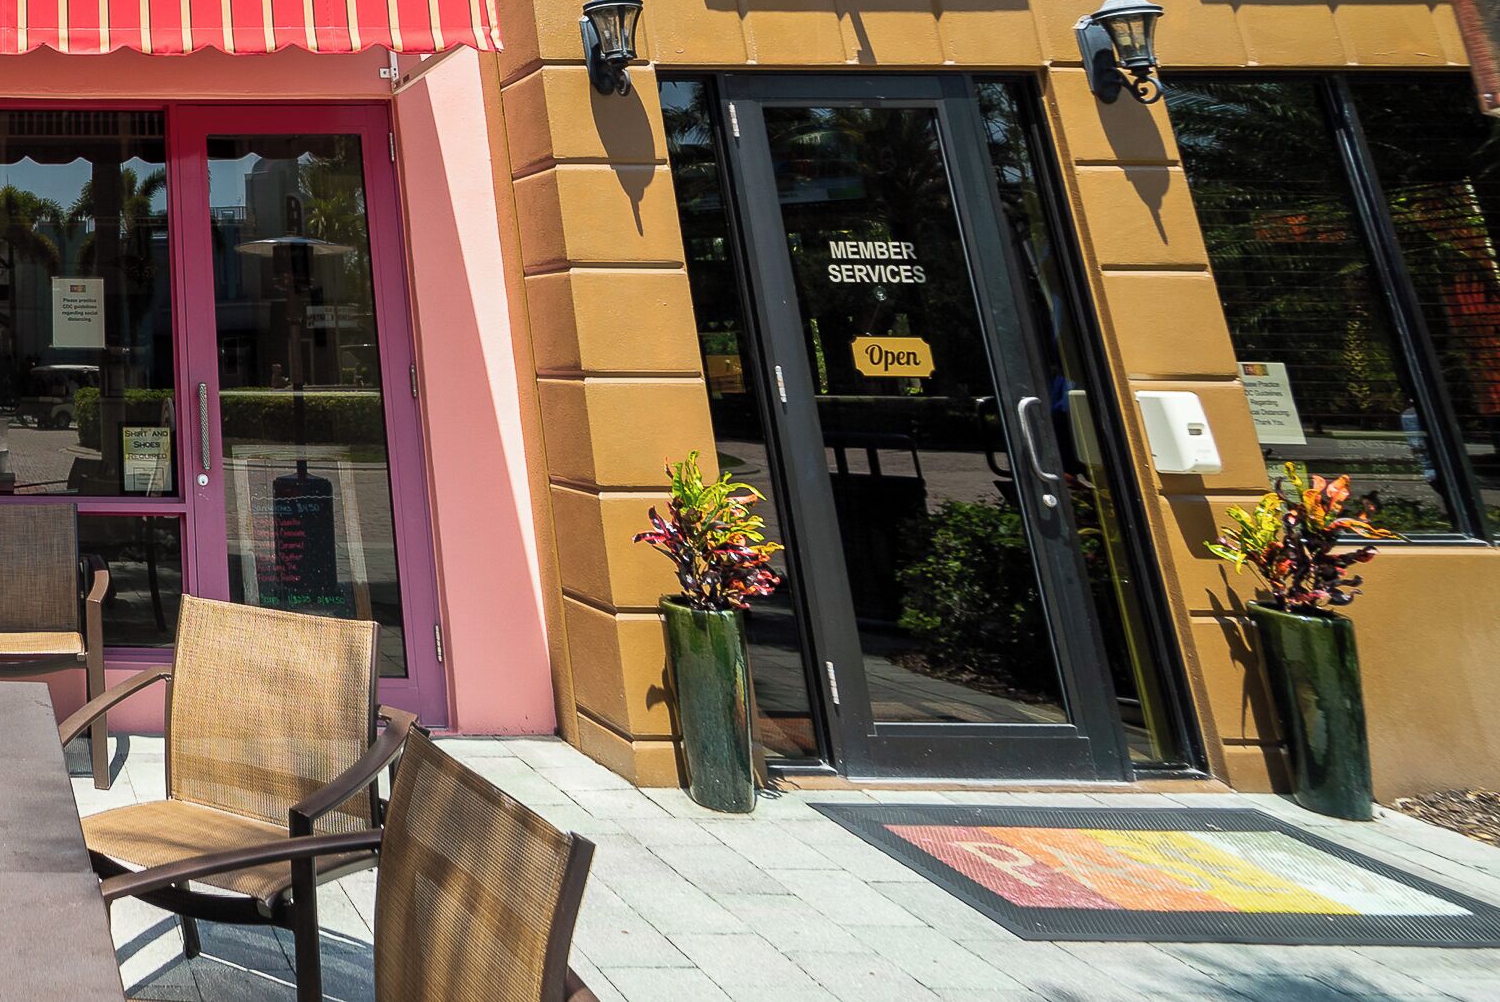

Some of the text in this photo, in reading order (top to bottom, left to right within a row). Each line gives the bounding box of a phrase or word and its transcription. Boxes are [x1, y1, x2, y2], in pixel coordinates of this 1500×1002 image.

[829, 241, 917, 260] MEMBER
[828, 265, 927, 283] SERVICES
[865, 344, 921, 372] Open
[1250, 399, 1279, 407] Regarding
[124, 430, 169, 438] SHIRT AND
[133, 441, 161, 449] SHOES
[127, 453, 168, 461] REQUIRED
